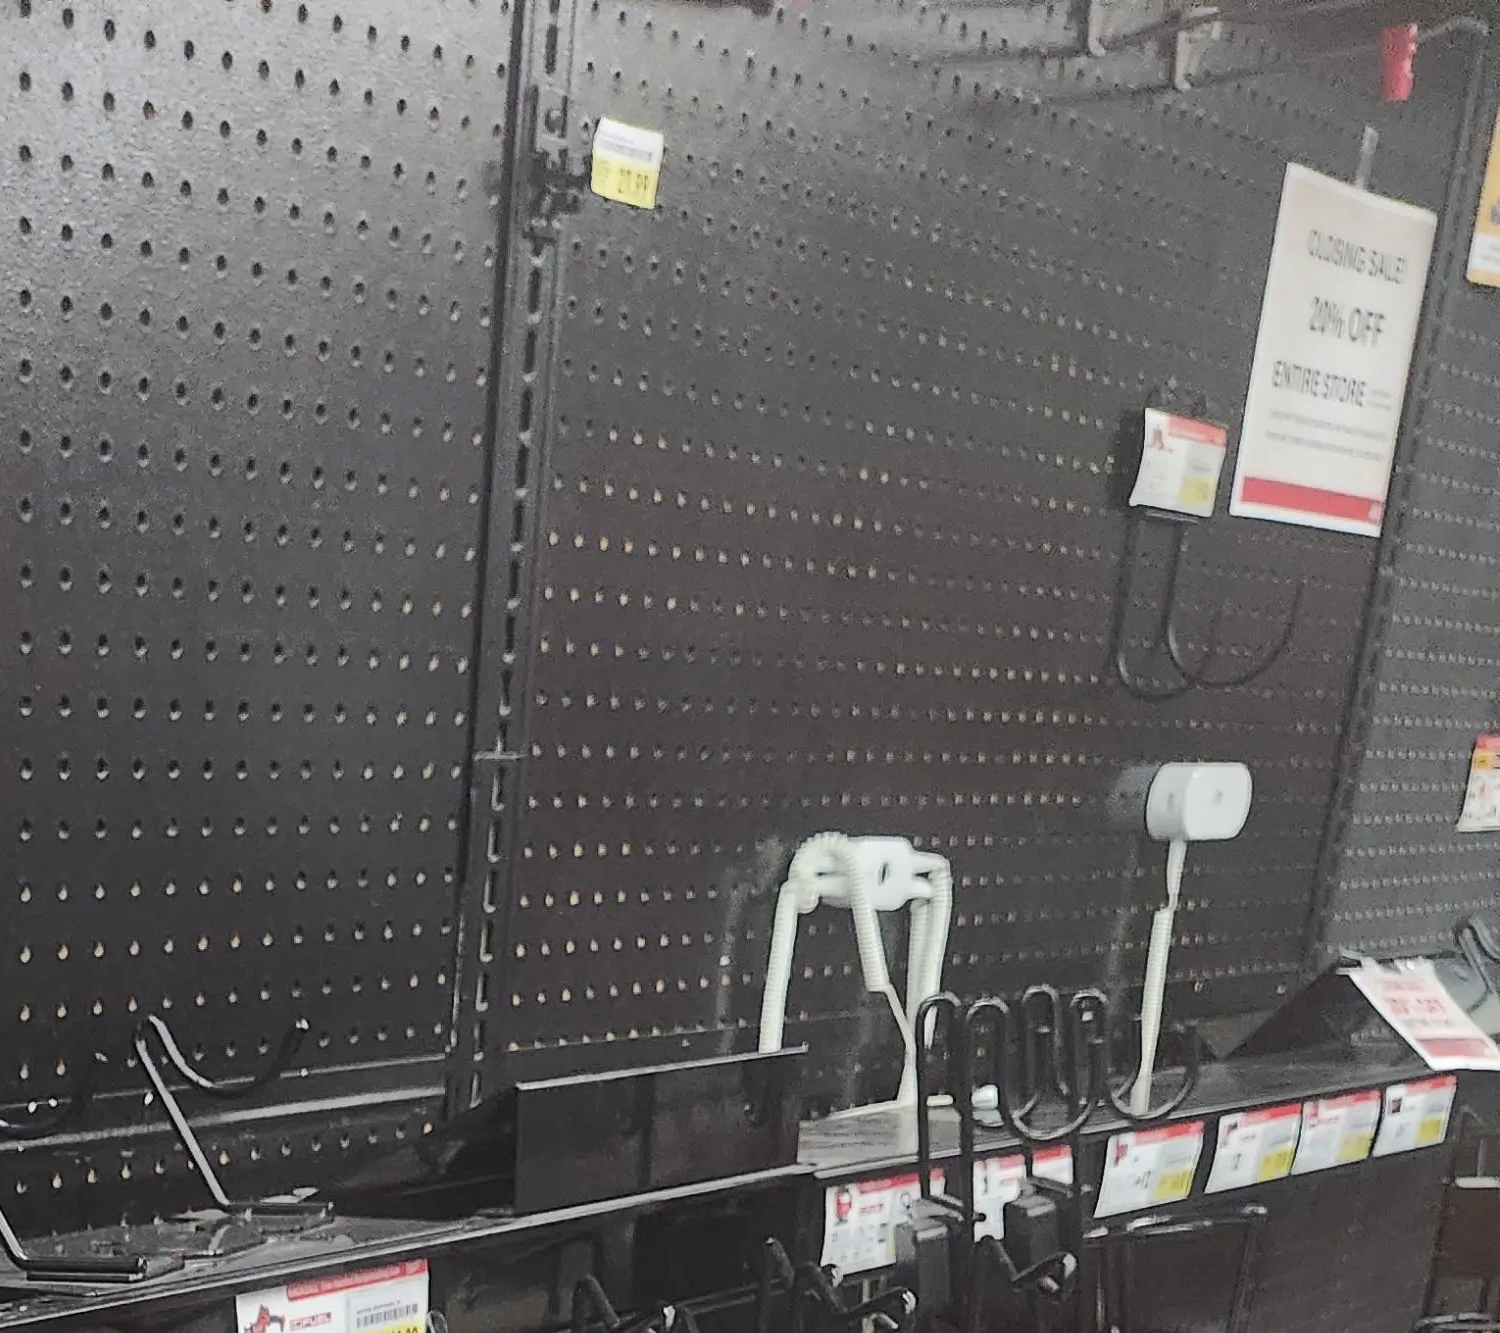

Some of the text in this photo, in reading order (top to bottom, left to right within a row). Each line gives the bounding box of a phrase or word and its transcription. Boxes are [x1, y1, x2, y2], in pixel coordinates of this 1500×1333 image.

[1307, 228, 1367, 271] CLOSING
[1308, 297, 1387, 350] 20% OFF
[1271, 359, 1322, 398] ENTIRE
[1322, 371, 1368, 408] STORE
